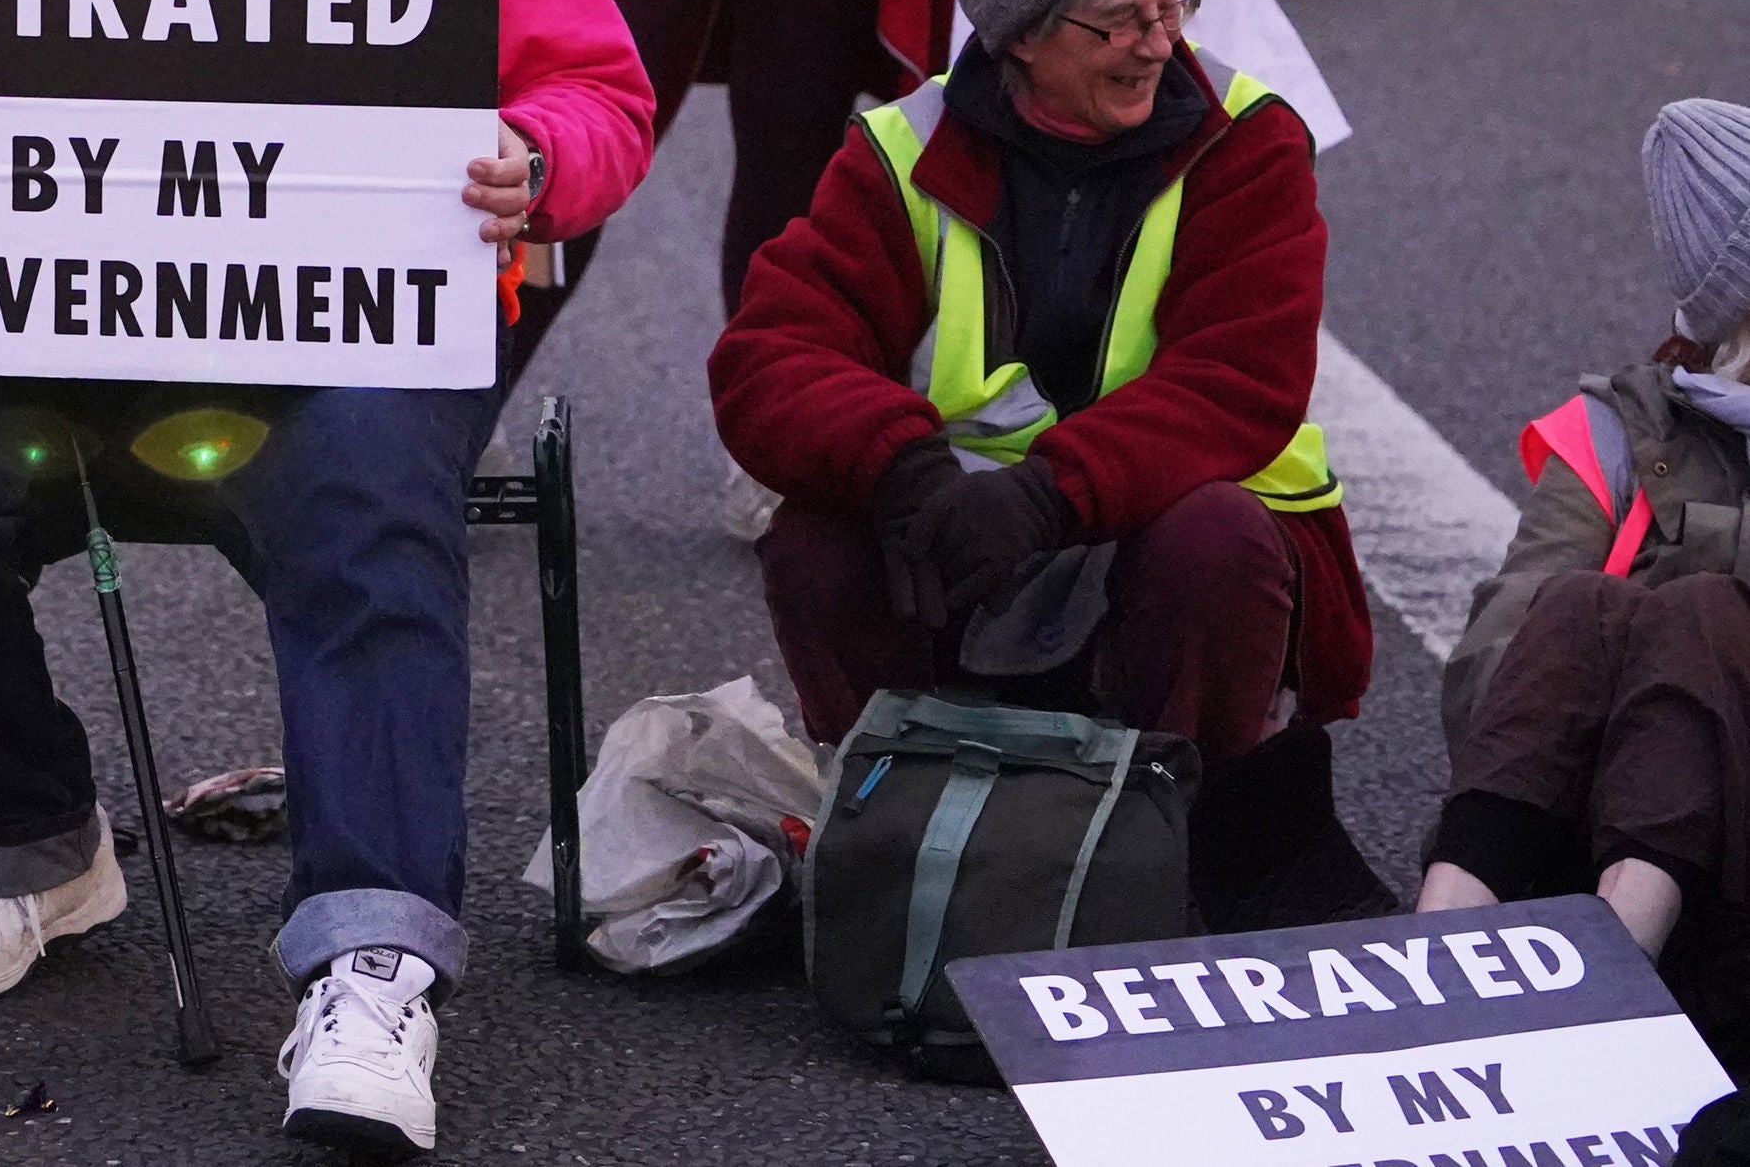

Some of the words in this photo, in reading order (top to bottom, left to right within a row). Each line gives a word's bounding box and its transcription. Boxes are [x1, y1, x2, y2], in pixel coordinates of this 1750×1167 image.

[11, 135, 121, 215] BY
[156, 139, 285, 219] MY
[1018, 925, 1586, 1042] BETRAYED
[1237, 1081, 1356, 1141] BY
[1386, 1063, 1516, 1126] MY
